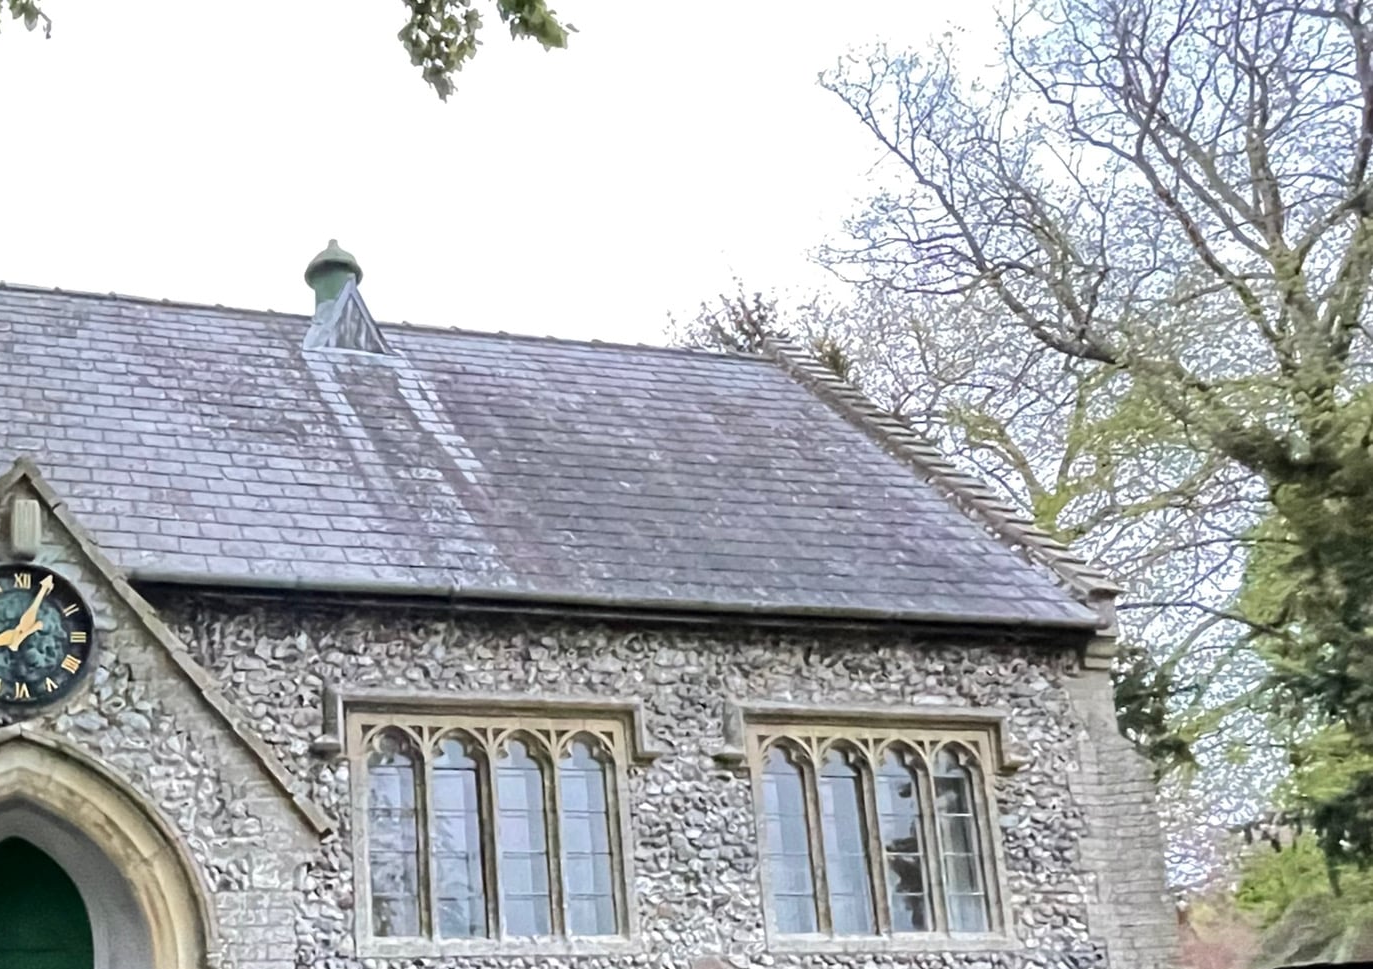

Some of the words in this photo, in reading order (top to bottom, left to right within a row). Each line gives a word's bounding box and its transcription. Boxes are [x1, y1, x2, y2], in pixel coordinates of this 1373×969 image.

[13, 573, 31, 590] XII
[62, 603, 80, 617] II
[15, 682, 30, 699] VI
[45, 677, 59, 693] V
